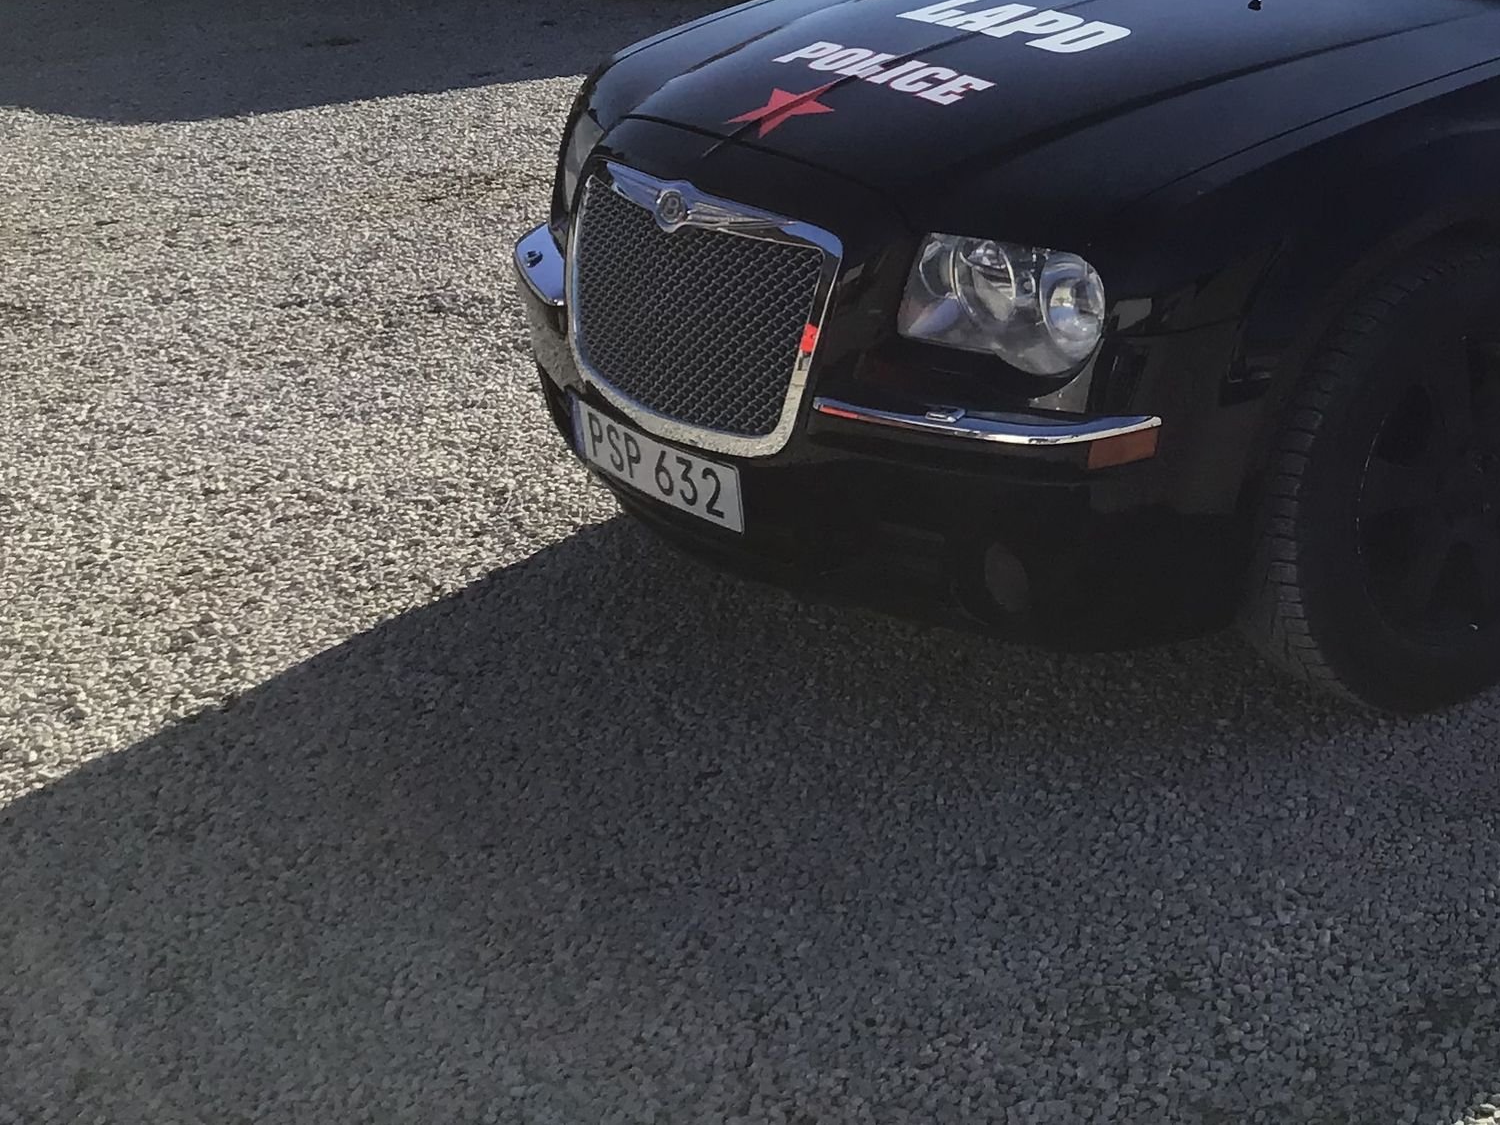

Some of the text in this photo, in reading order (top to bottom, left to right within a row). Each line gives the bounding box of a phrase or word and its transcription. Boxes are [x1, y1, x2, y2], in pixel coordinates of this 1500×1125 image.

[772, 41, 996, 106] POLICE
[587, 412, 725, 519] PSP 632
